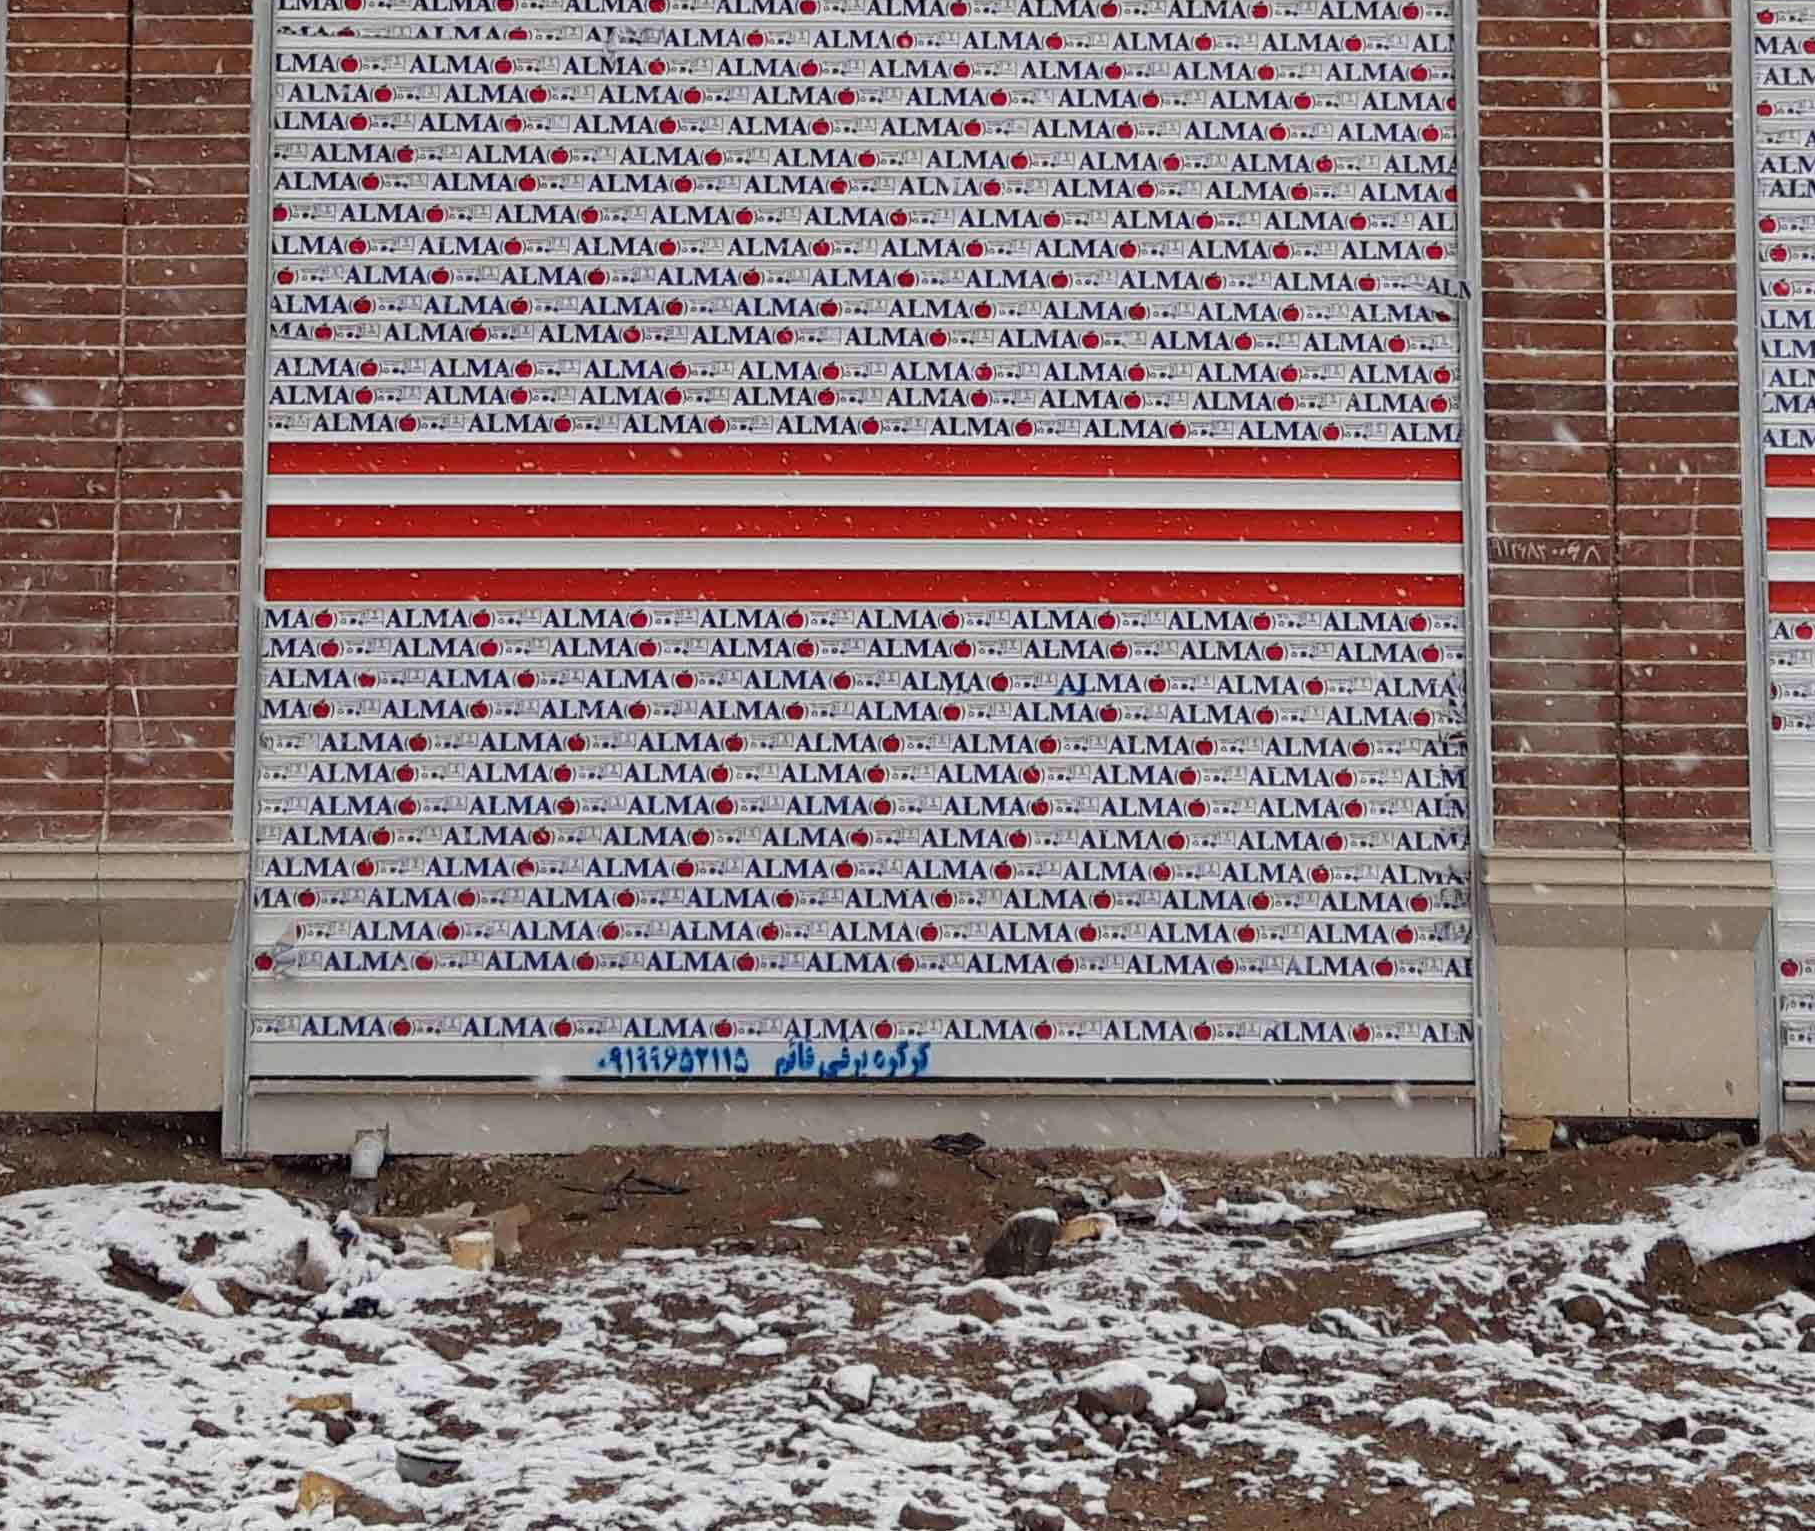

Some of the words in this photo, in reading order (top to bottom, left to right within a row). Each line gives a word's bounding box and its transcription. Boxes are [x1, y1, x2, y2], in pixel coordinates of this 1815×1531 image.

[287, 82, 369, 103] ALMA
[443, 83, 525, 104] ALMA
[597, 84, 680, 105] ALMA
[752, 85, 833, 106] ALMA
[905, 86, 986, 107] ALMA
[1057, 87, 1138, 109] ALMA
[1209, 89, 1290, 110] ALMA
[268, 294, 349, 315] ALMA
[423, 294, 507, 315] ALMA
[577, 295, 661, 316] ALMA
[733, 297, 815, 318] ALMA
[888, 298, 971, 319] ALMA
[1042, 300, 1123, 321] ALMA
[1196, 301, 1278, 323] ALMA
[1350, 303, 1432, 323] ALMA
[380, 698, 466, 719] ALMA
[539, 698, 624, 720] ALMA
[698, 699, 781, 721] ALMA
[855, 700, 938, 722] ALMA
[1012, 701, 1095, 723] ALMA
[1169, 703, 1252, 725] ALMA
[1325, 705, 1409, 727] ALMA
[323, 950, 405, 972] ALMA
[484, 949, 570, 972] ALMA
[644, 950, 731, 972] ALMA
[805, 951, 890, 973] ALMA
[965, 952, 1050, 974] ALMA
[1125, 954, 1209, 975] ALMA
[1285, 955, 1369, 977] ALMA
